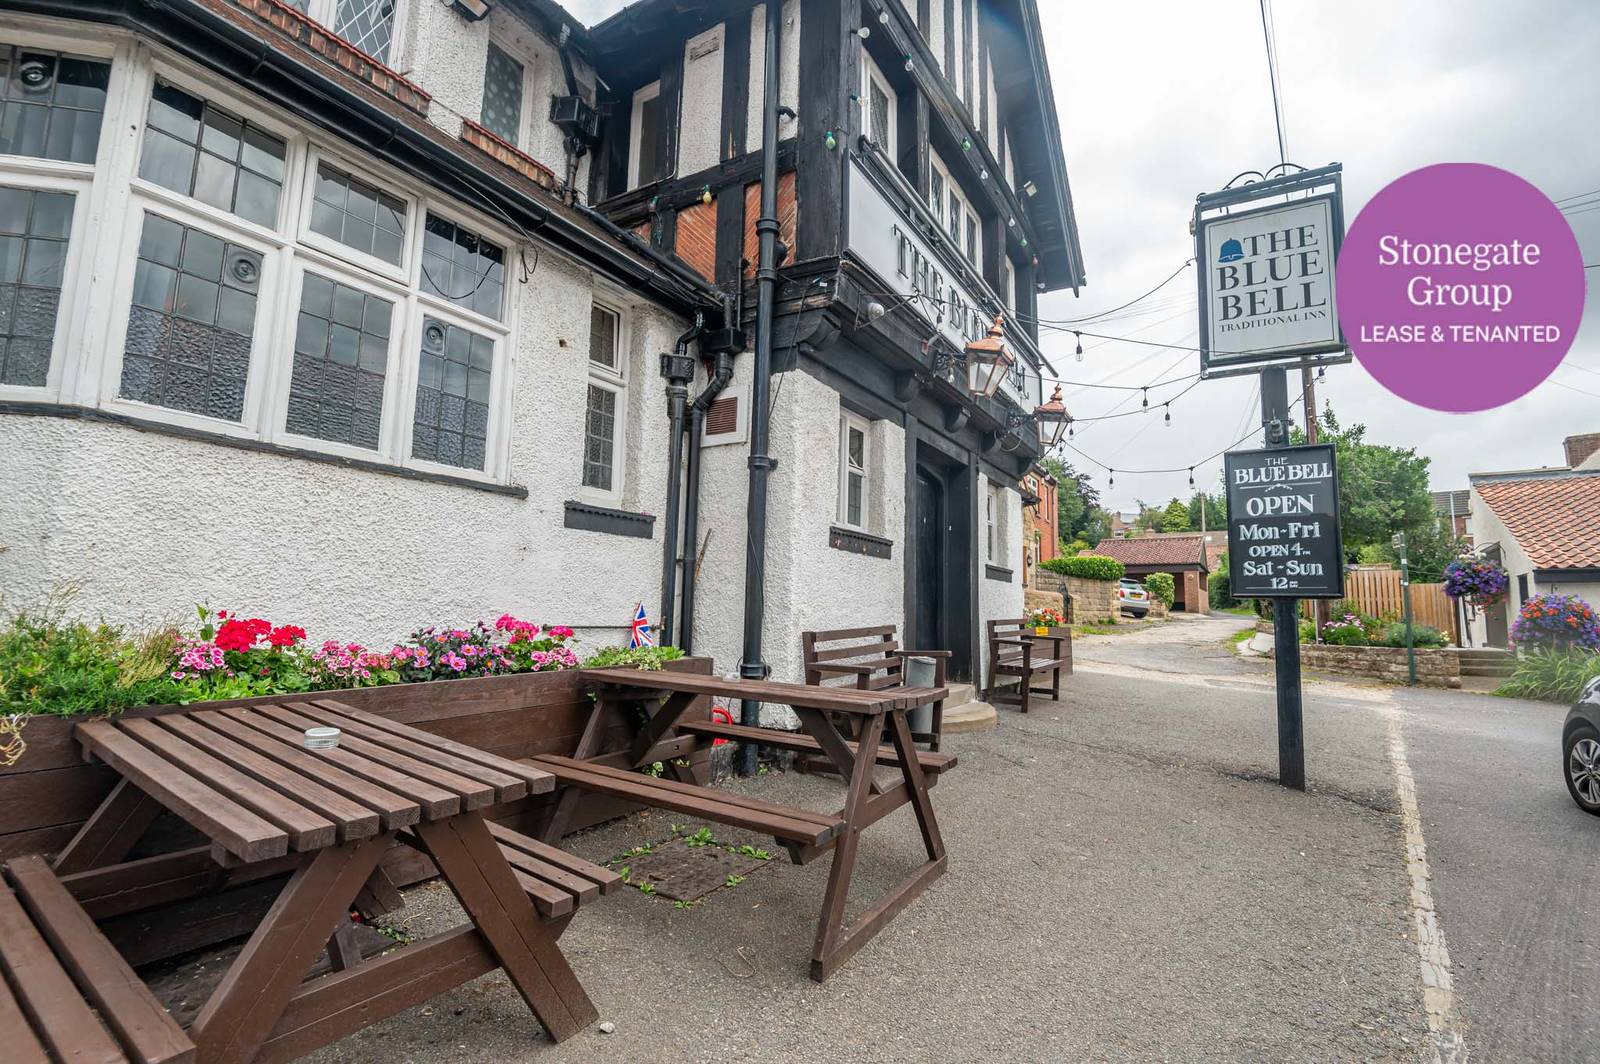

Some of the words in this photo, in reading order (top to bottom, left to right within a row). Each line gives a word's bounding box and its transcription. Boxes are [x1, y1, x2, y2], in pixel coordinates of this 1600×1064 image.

[1243, 224, 1318, 258] THE
[892, 223, 945, 315] THE
[1216, 249, 1324, 292] BLUE
[1218, 281, 1327, 322] BELL
[1219, 313, 1299, 332] TRADITIONAL
[1304, 309, 1327, 320] INN
[1264, 456, 1289, 466] THE
[1246, 493, 1315, 518] OPEN
[1248, 543, 1289, 558] OPEN
